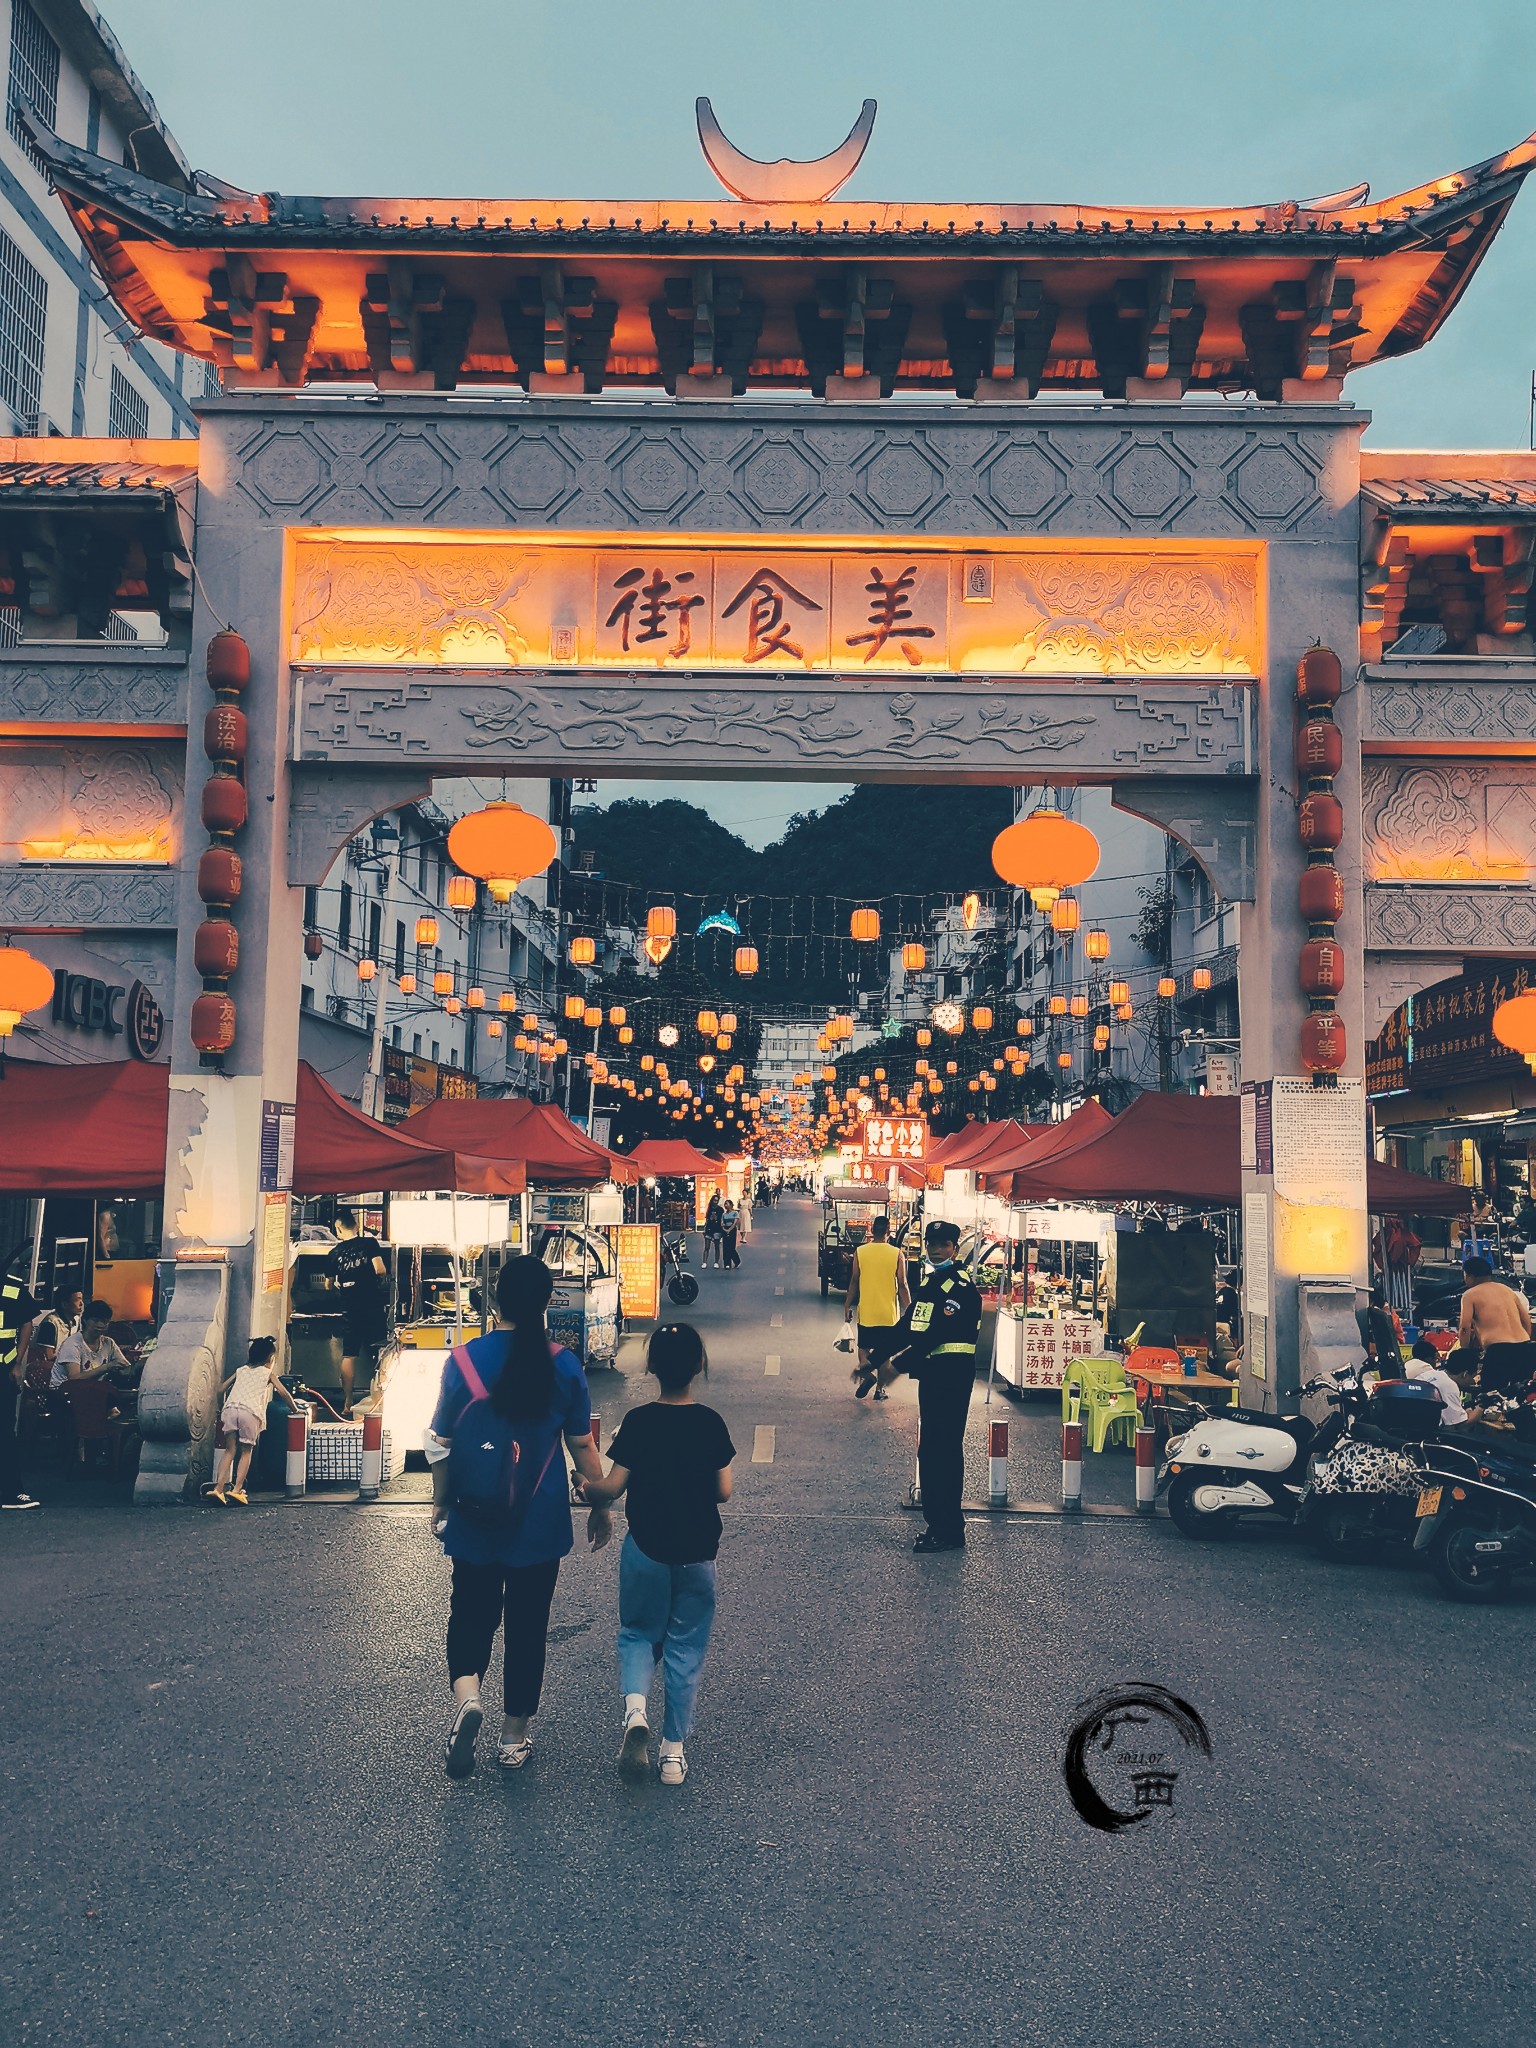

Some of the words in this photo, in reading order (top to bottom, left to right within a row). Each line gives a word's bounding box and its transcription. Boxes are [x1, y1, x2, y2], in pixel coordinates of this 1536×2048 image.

[216, 712, 237, 750] 法治
[1307, 726, 1326, 764] 民主
[1300, 801, 1316, 837] 文明
[1318, 948, 1334, 986] 自由
[52, 968, 125, 1034] ICBC
[217, 1003, 235, 1041] 友善
[1316, 1018, 1337, 1059] 平等
[1026, 1323, 1055, 1336] 云吞
[1063, 1324, 1092, 1338] 饺子
[1026, 1339, 1056, 1353] 云吞面
[1061, 1340, 1092, 1355] 牛腩面
[1026, 1355, 1055, 1369] 汤粉
